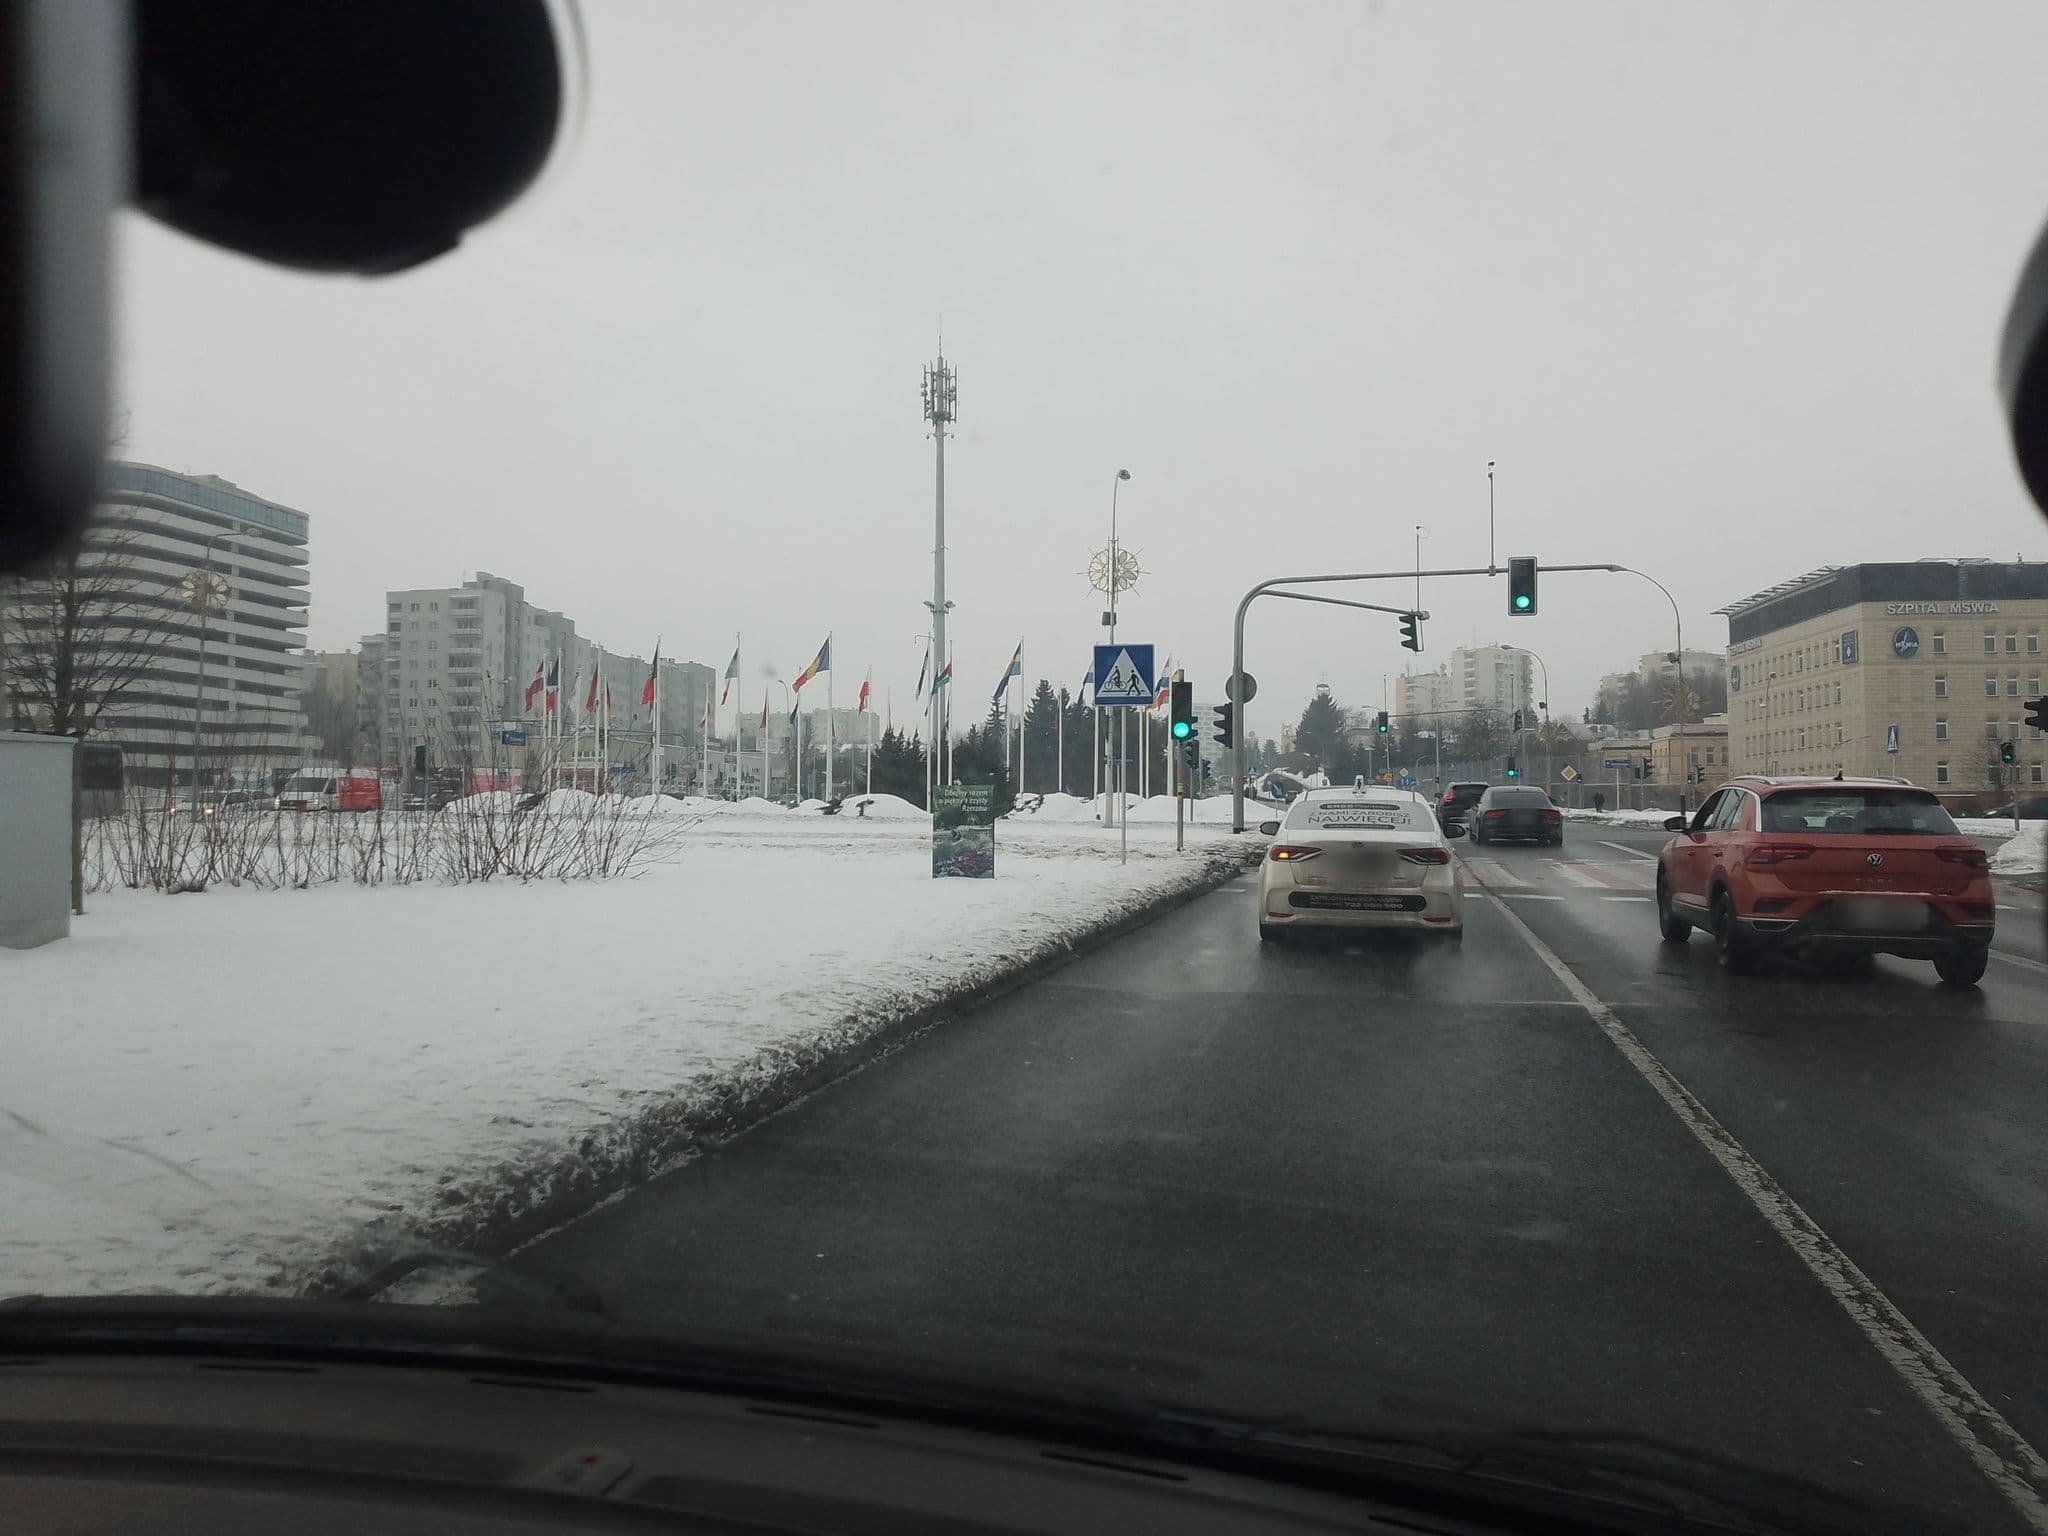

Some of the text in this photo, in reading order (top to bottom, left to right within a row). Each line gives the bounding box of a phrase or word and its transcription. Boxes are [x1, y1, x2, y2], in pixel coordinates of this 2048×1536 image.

[1887, 603, 1945, 615] SZPITAL
[969, 797, 988, 805] czysty
[962, 804, 988, 812] Rzeszów
